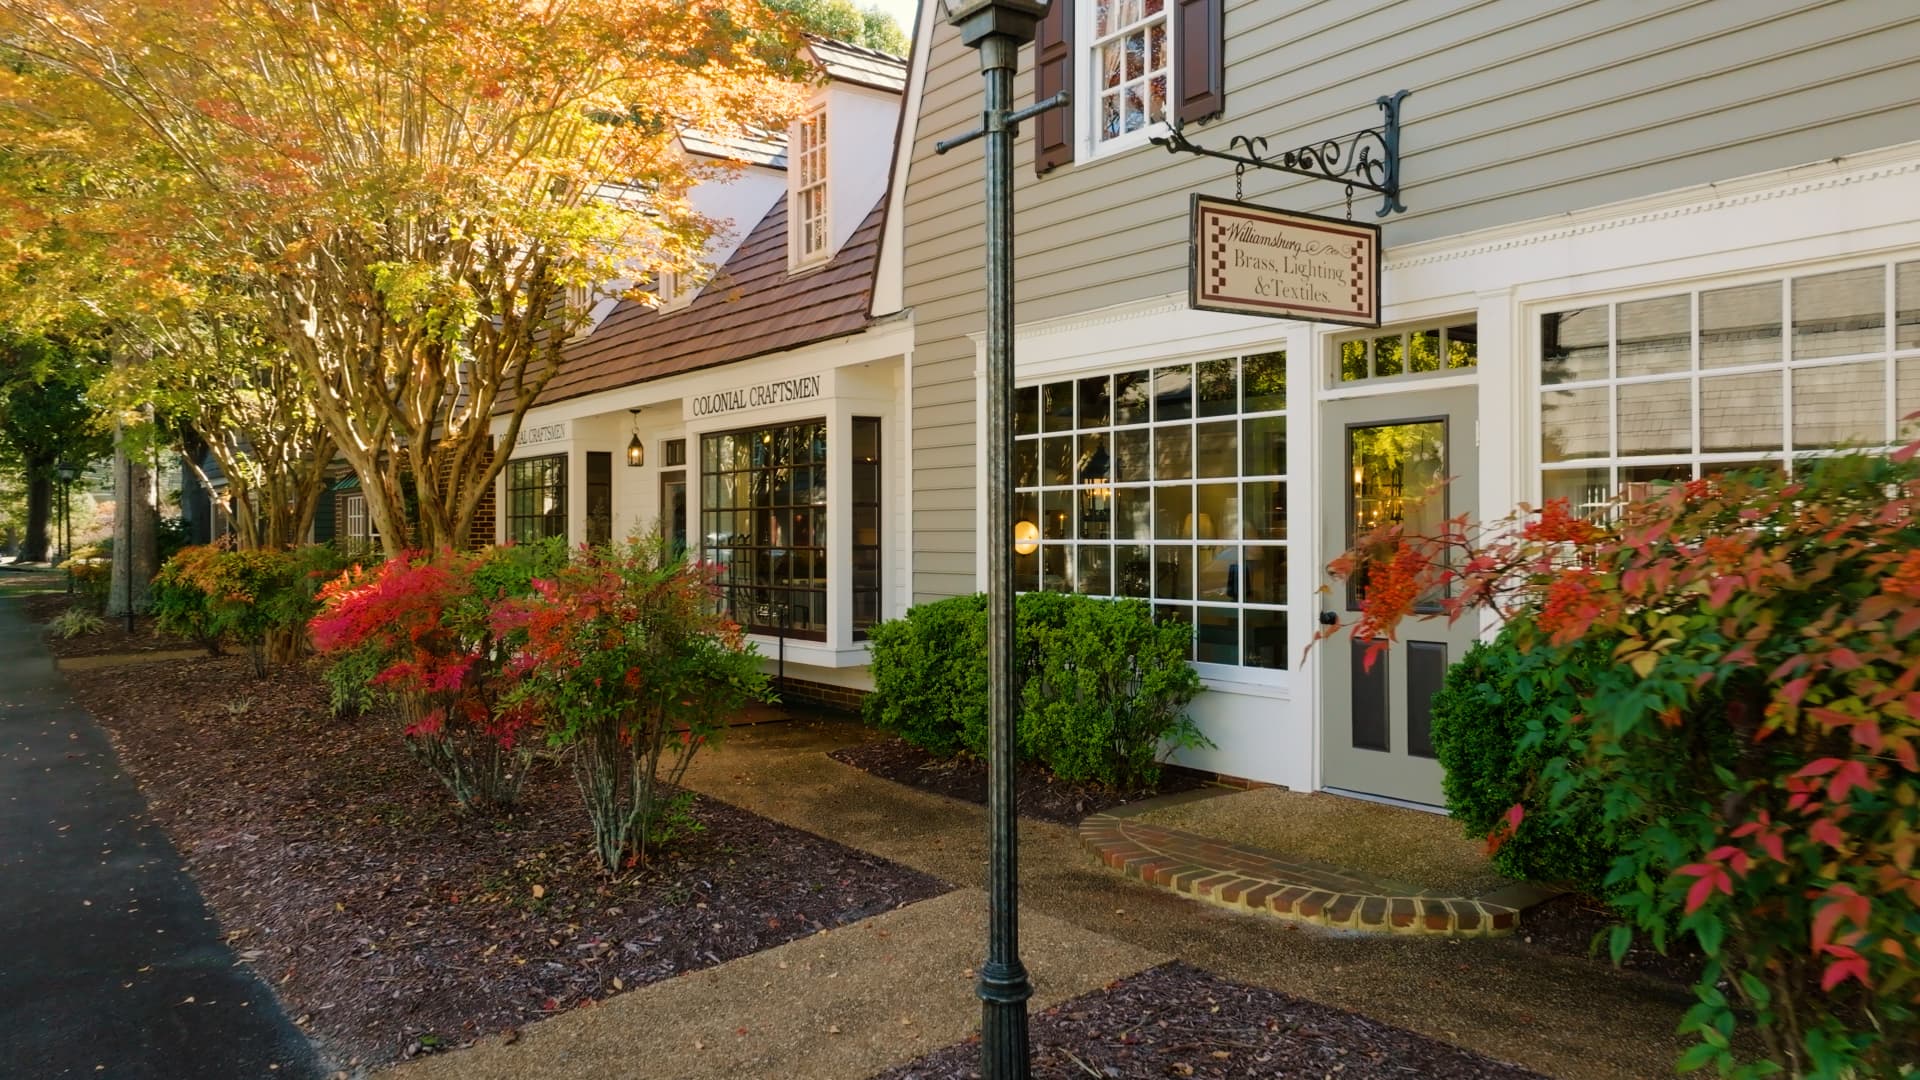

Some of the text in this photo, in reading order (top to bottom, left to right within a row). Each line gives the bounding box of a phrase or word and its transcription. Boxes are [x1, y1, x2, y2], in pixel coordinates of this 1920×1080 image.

[1226, 220, 1302, 259] Williamsburg
[1283, 255, 1347, 287] Lighting
[692, 375, 821, 416] COLONIAL CRAFTSMEN
